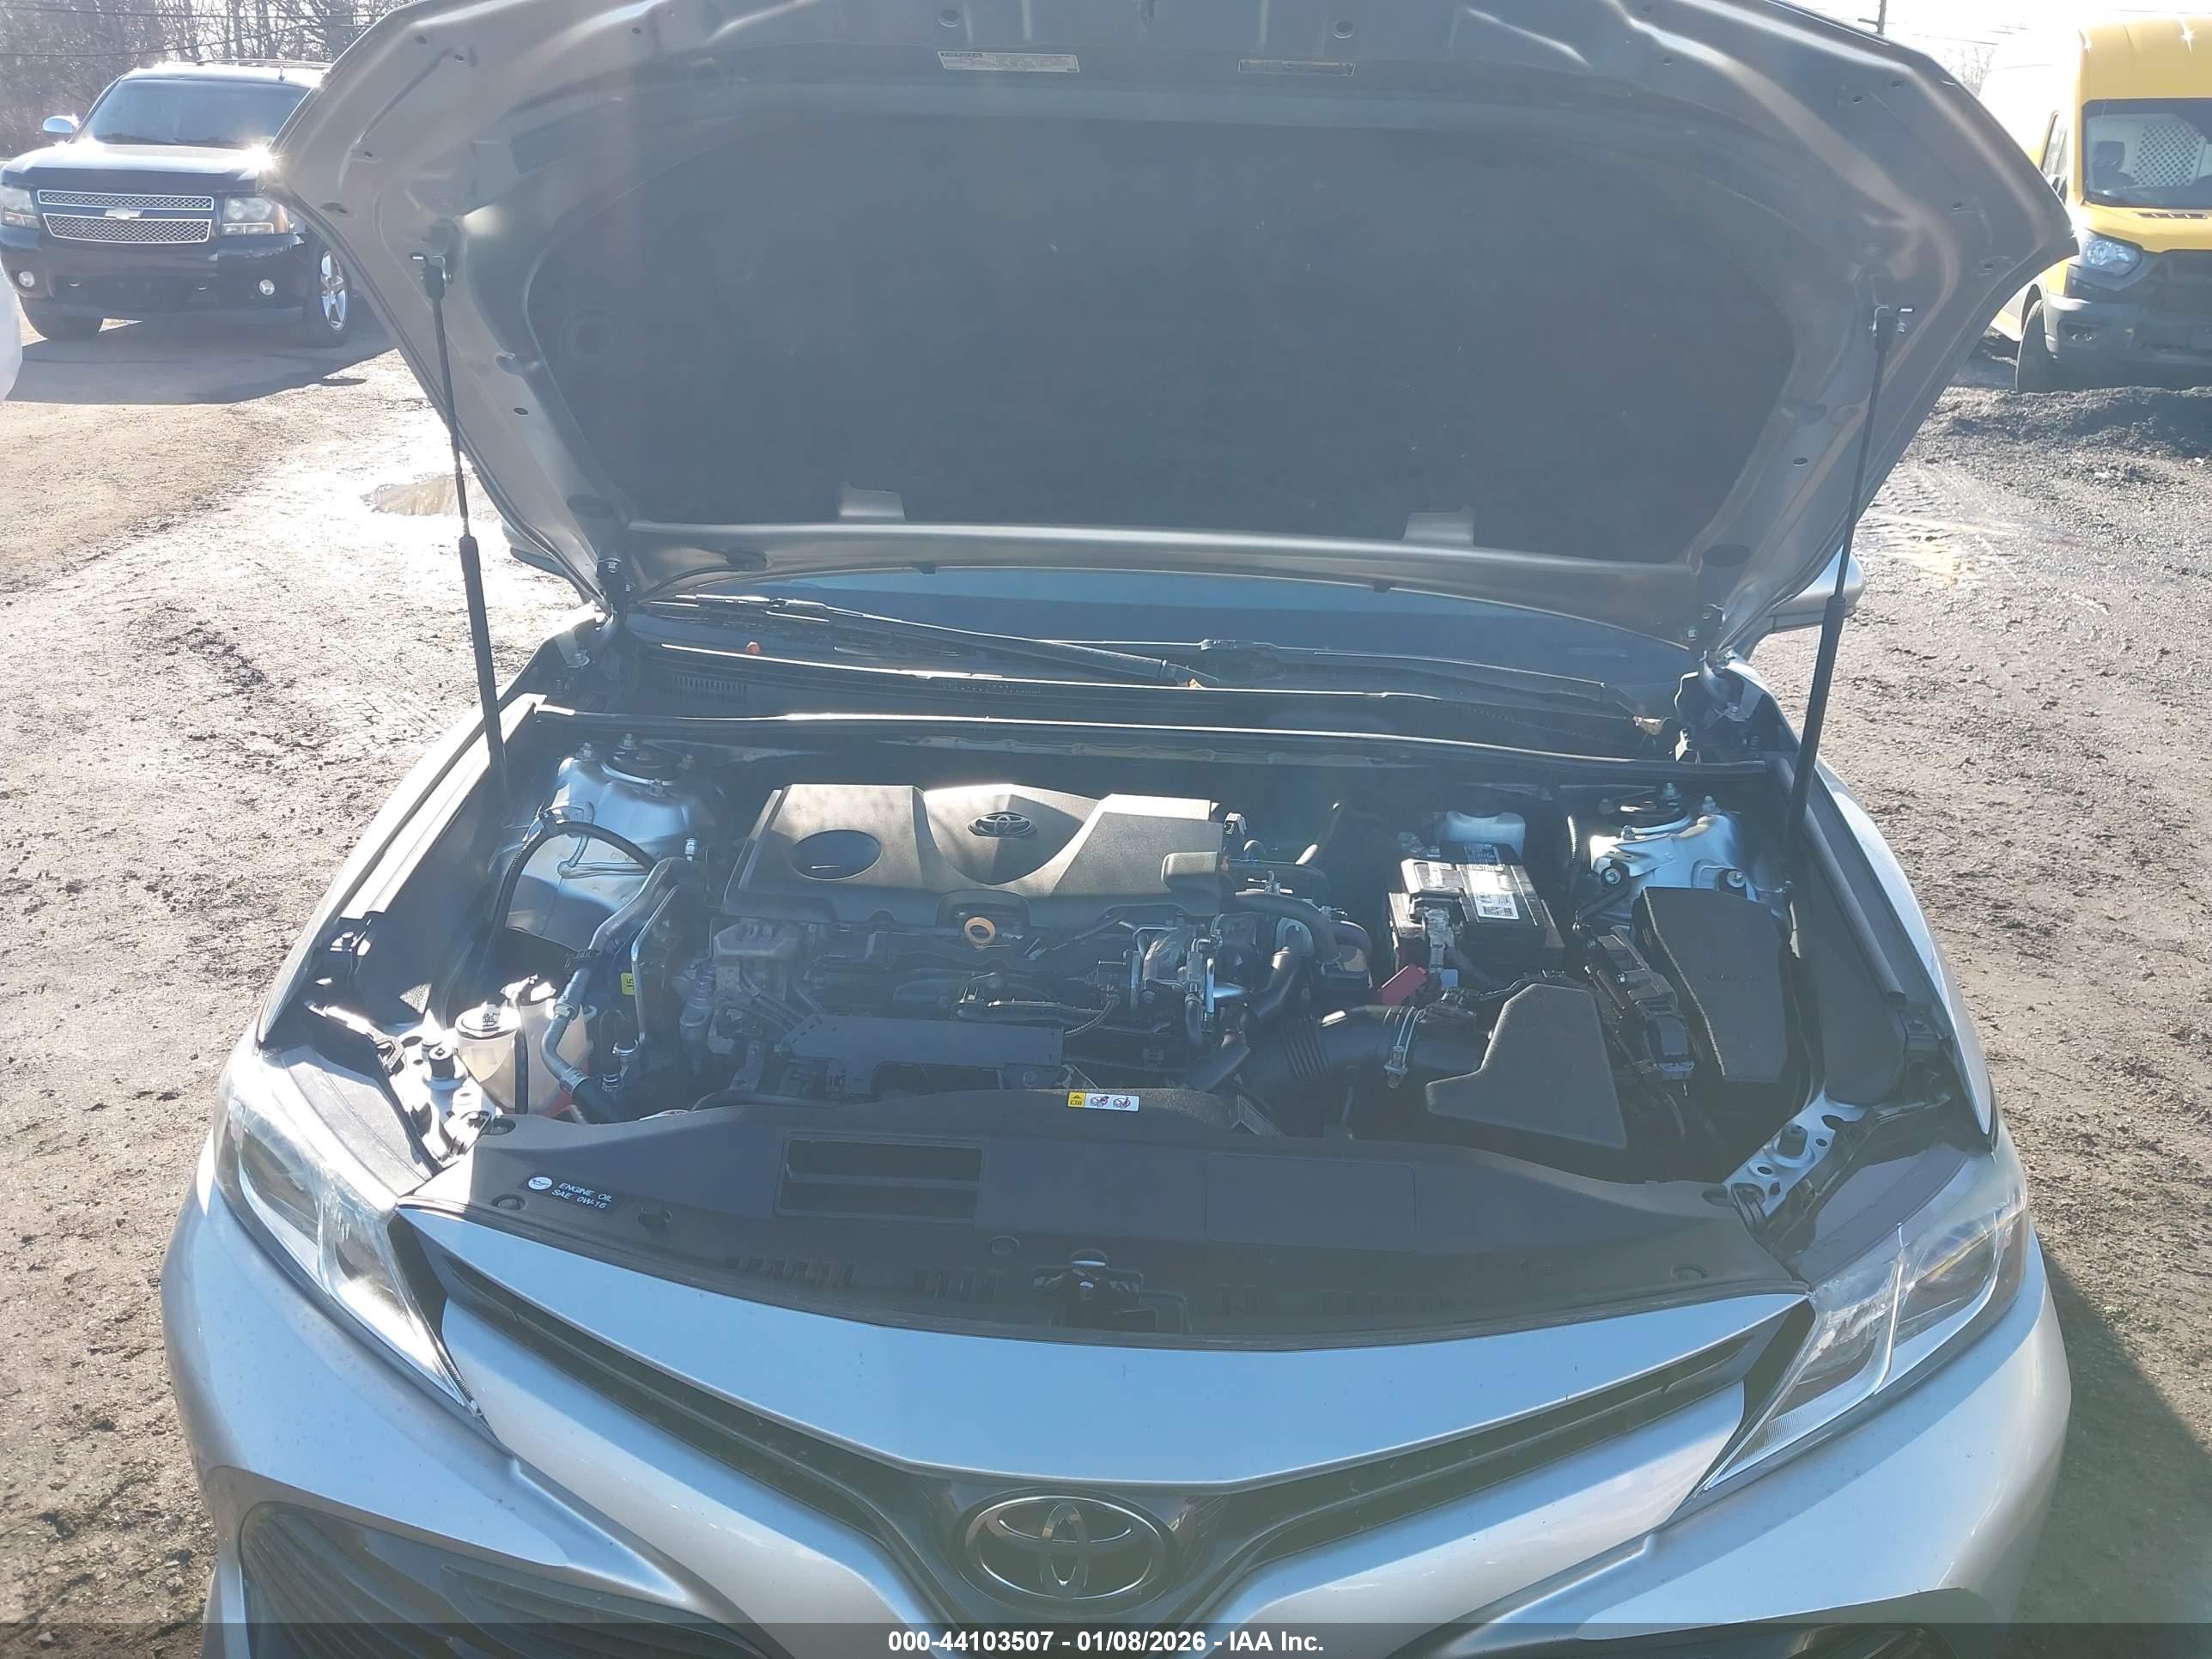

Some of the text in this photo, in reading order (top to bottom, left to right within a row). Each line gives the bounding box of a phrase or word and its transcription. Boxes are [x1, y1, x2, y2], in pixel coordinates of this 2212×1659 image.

[551, 1189, 607, 1209] SAE 0W-16
[558, 1182, 612, 1203] ENGINE OIL
